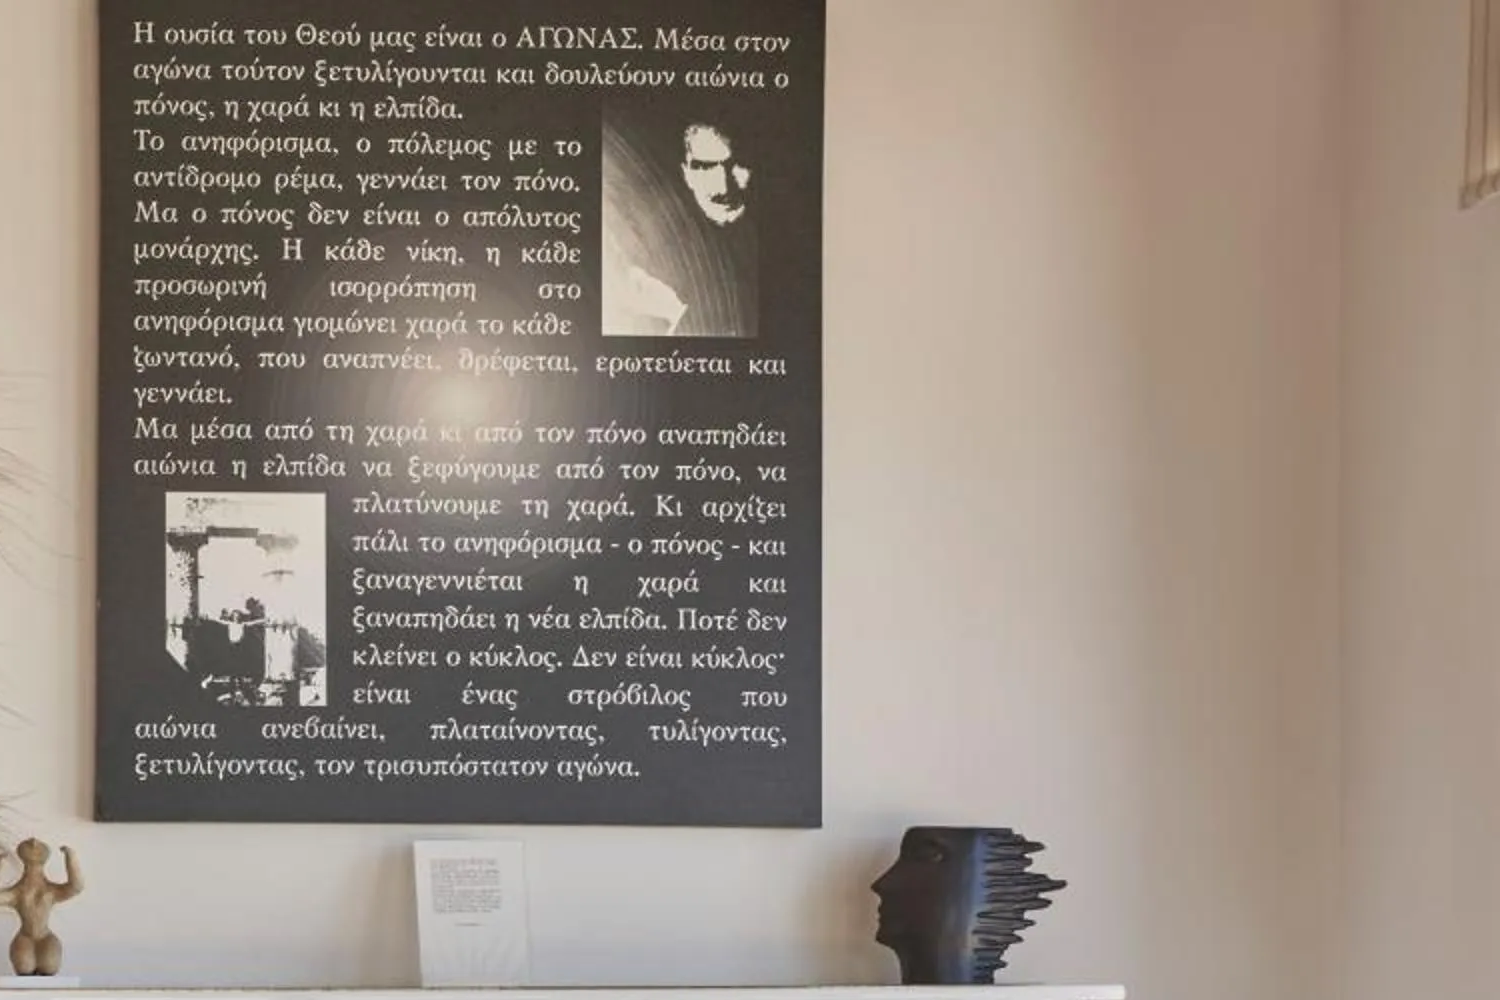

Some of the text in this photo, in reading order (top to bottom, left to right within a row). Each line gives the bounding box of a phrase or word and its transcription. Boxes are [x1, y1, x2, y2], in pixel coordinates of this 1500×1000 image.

[135, 21, 790, 54] Η ουσία του Θεού μας είναι ο ΑΓΩΝΑΣ. Μέσα στον
[134, 56, 789, 89] αγώνα τούτον ξετυλίγουνται και δουλεύουν αιώνια ο
[134, 92, 463, 123] πόνος, η χαρά κι η ελπίδα.
[134, 128, 581, 162] Το ανηφόρισμα, ο πόλεμος με το
[134, 163, 580, 195] αντίδρομο ρέμα, γεννάει τον πόνο.
[135, 200, 581, 234] Μα ο πόνος δεν είναι ο απόλυτος
[134, 236, 258, 266] μονάρχης.
[283, 238, 302, 260] Η
[486, 246, 500, 267] η
[135, 271, 581, 304] προσωρινή ισορρόπηση στο
[134, 307, 284, 337] ανηφόρισμα
[293, 309, 396, 339] γιομώνει
[406, 311, 467, 339] χαρά
[477, 318, 504, 336] το
[258, 350, 305, 369] που
[596, 349, 731, 379] ερωτεύεται
[749, 358, 786, 376] και
[134, 379, 232, 409] γεννάει.
[135, 417, 178, 439] Μα
[191, 417, 252, 446] μέσα
[265, 417, 313, 440] από
[326, 424, 353, 444] τη
[366, 418, 426, 447] χαρά
[475, 419, 522, 442] από
[536, 425, 574, 443] τον
[587, 420, 646, 444] πόνο
[658, 422, 786, 450] αναπηδάει
[134, 452, 786, 485] αιώνια η ελπίδα να ξεφύγουμε από τον πόνο, να
[353, 490, 786, 524] πλατύνουμε τη χαρά. Κι αρχίζει
[353, 529, 408, 552] πάλι
[418, 535, 445, 553] το
[454, 530, 602, 560] ανηφόρισμα
[628, 538, 642, 554] ο
[651, 532, 723, 562] πόνος
[749, 539, 786, 556] και
[353, 567, 786, 599] ξαναγεννιέται η χαρά και
[353, 605, 787, 633] ξαναπηδάει η νέα ελπίδα. Ποτέ δεν
[353, 643, 437, 666] κλείνει
[446, 650, 461, 667] ο
[470, 643, 562, 673] κύκλος.
[572, 645, 617, 667] Δεν
[626, 644, 682, 669] είναι
[353, 681, 411, 704] είναι
[462, 681, 518, 711] ένας
[742, 690, 787, 708] που
[135, 715, 216, 738] αιώνια
[430, 716, 604, 746] πλαταίνοντας,
[649, 717, 786, 748] τυλίγοντας,
[135, 751, 639, 782] ξετυλίγοντας, τον τρισυπόστατον αγώνα.
